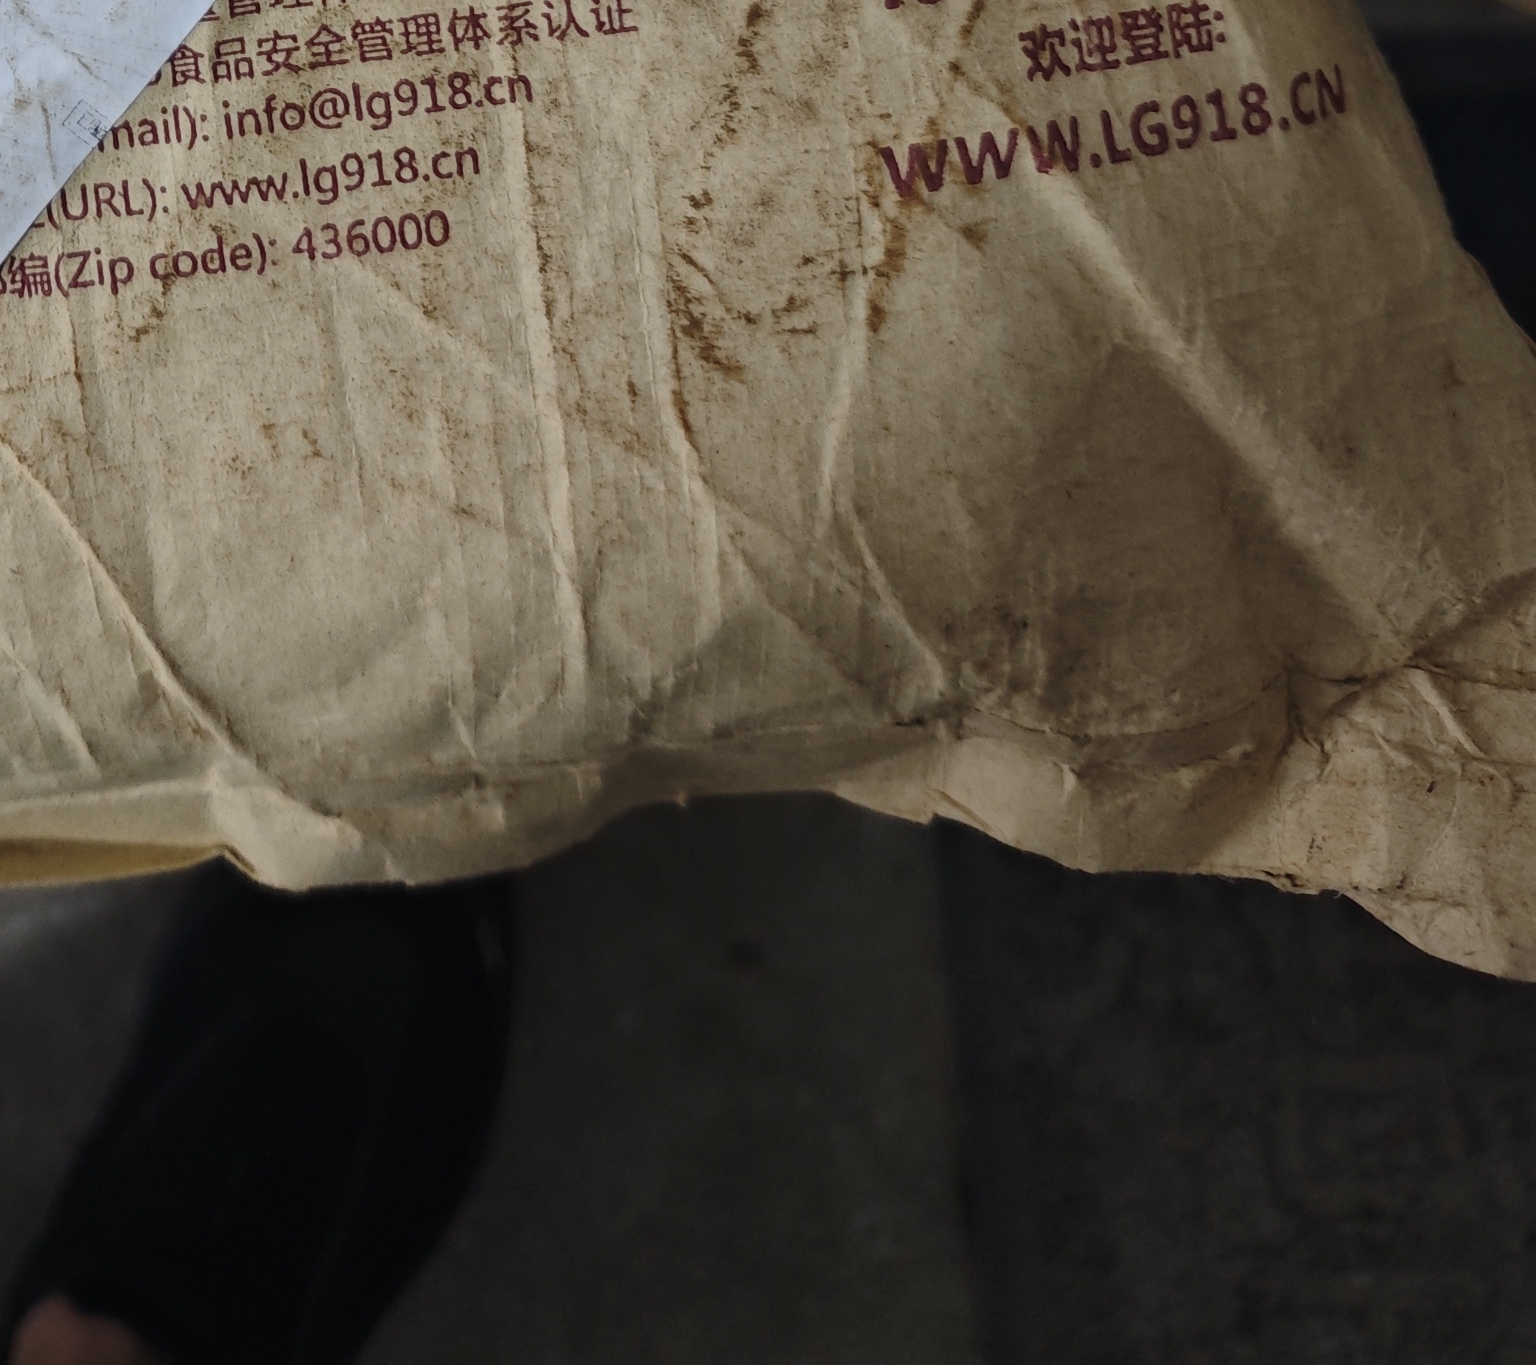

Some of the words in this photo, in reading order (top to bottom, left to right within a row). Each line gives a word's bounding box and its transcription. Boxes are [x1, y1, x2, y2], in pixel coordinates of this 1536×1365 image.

[222, 71, 534, 139] info@lg918.cn
[33, 177, 170, 230] (URL):
[181, 146, 482, 211] www.lg918.cn
[149, 232, 278, 282] code):
[291, 209, 451, 262] 436000
